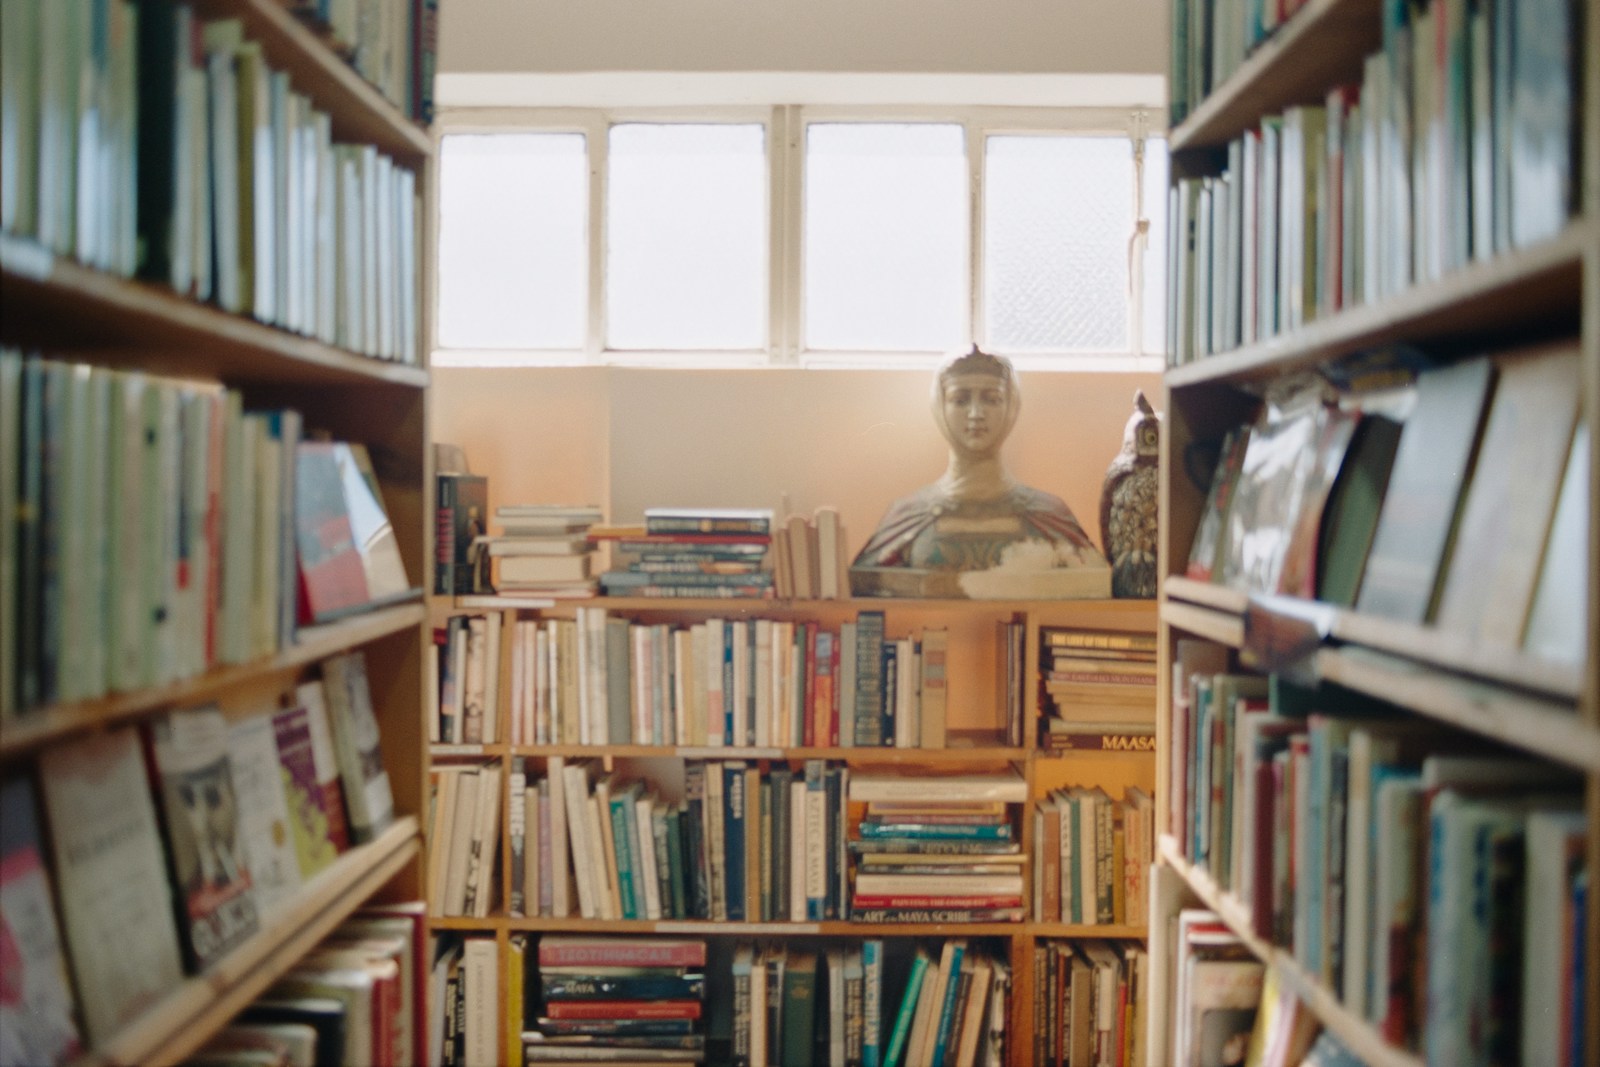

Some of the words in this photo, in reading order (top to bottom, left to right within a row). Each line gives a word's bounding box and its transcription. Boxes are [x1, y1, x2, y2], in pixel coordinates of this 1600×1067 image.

[510, 773, 526, 836] OLMEC
[811, 797, 820, 835] AZTEC
[811, 857, 820, 894] MAYA
[863, 910, 887, 922] ART
[898, 911, 929, 922] MAYA
[931, 911, 971, 922] SCRIBE
